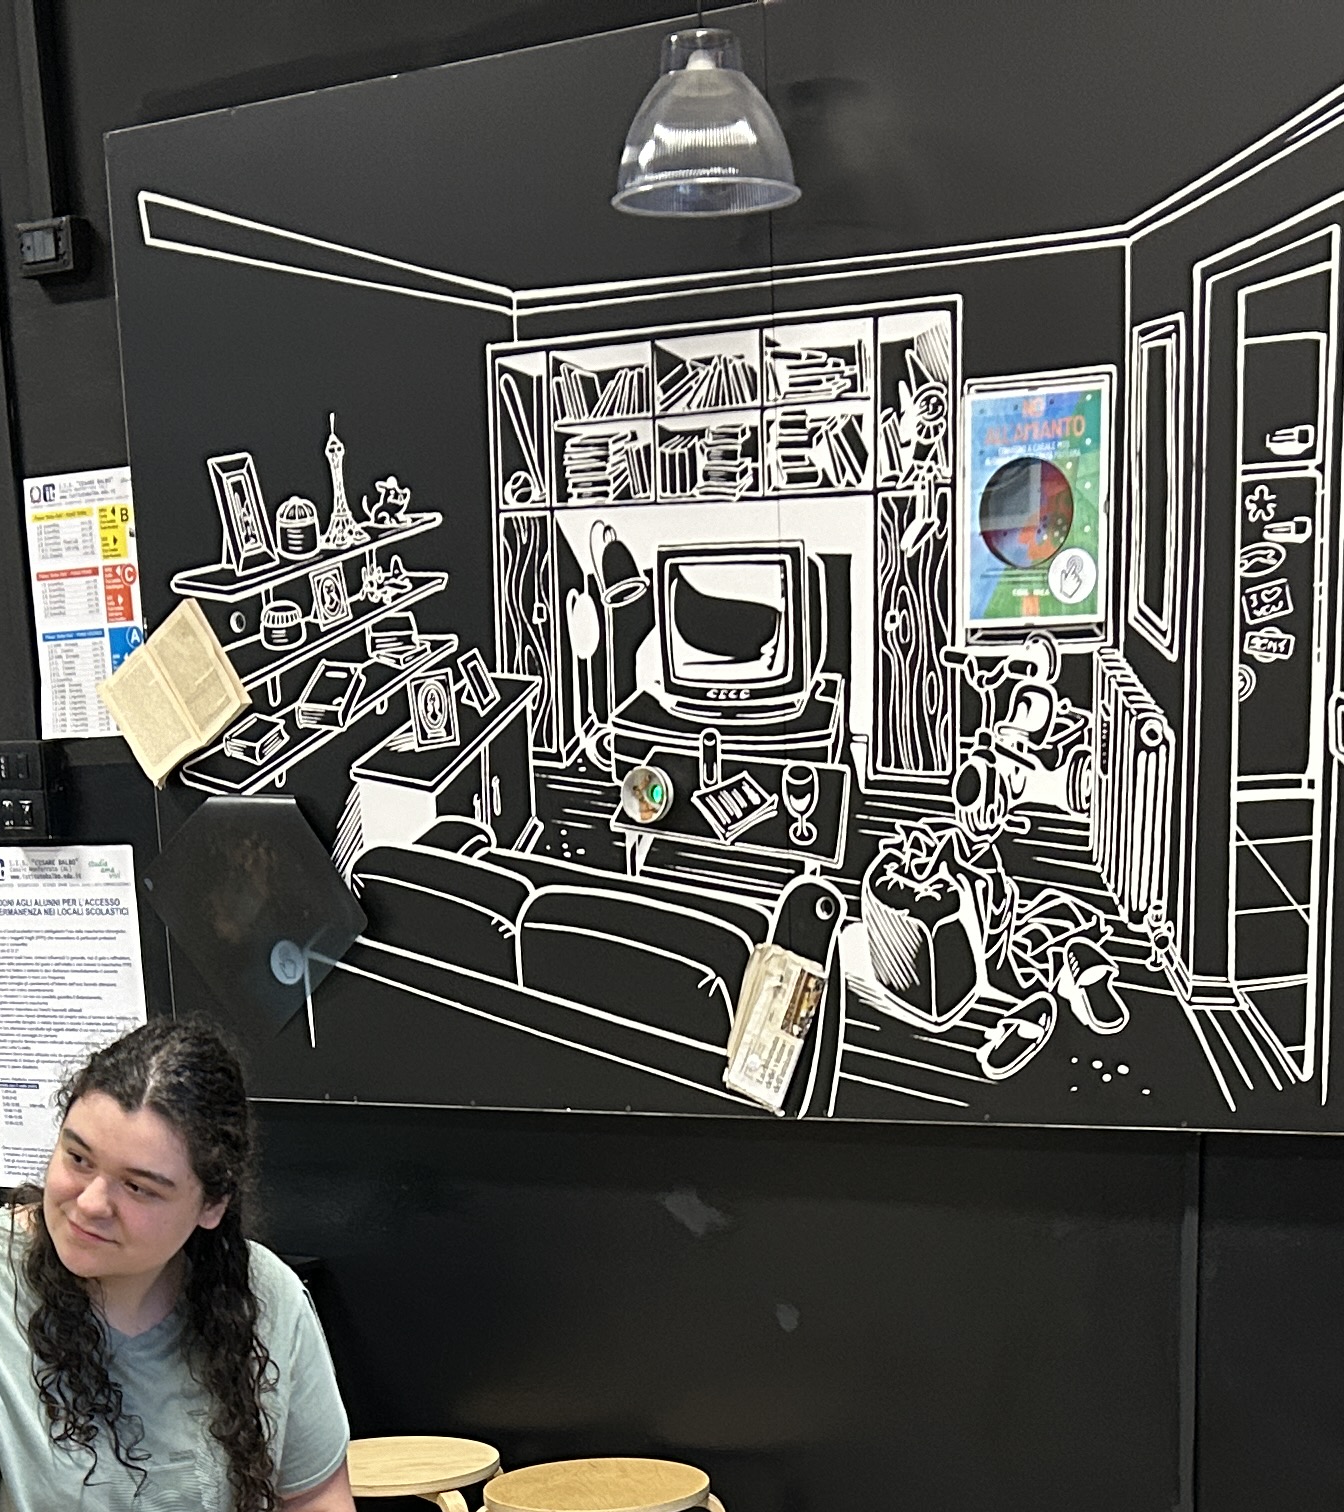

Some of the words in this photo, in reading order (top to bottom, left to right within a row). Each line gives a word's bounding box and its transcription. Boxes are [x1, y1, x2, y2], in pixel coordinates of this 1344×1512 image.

[120, 507, 129, 522] B
[124, 566, 134, 582] C
[130, 628, 141, 644] A
[62, 898, 77, 906] PER
[85, 907, 129, 915] SCOLASTICI
